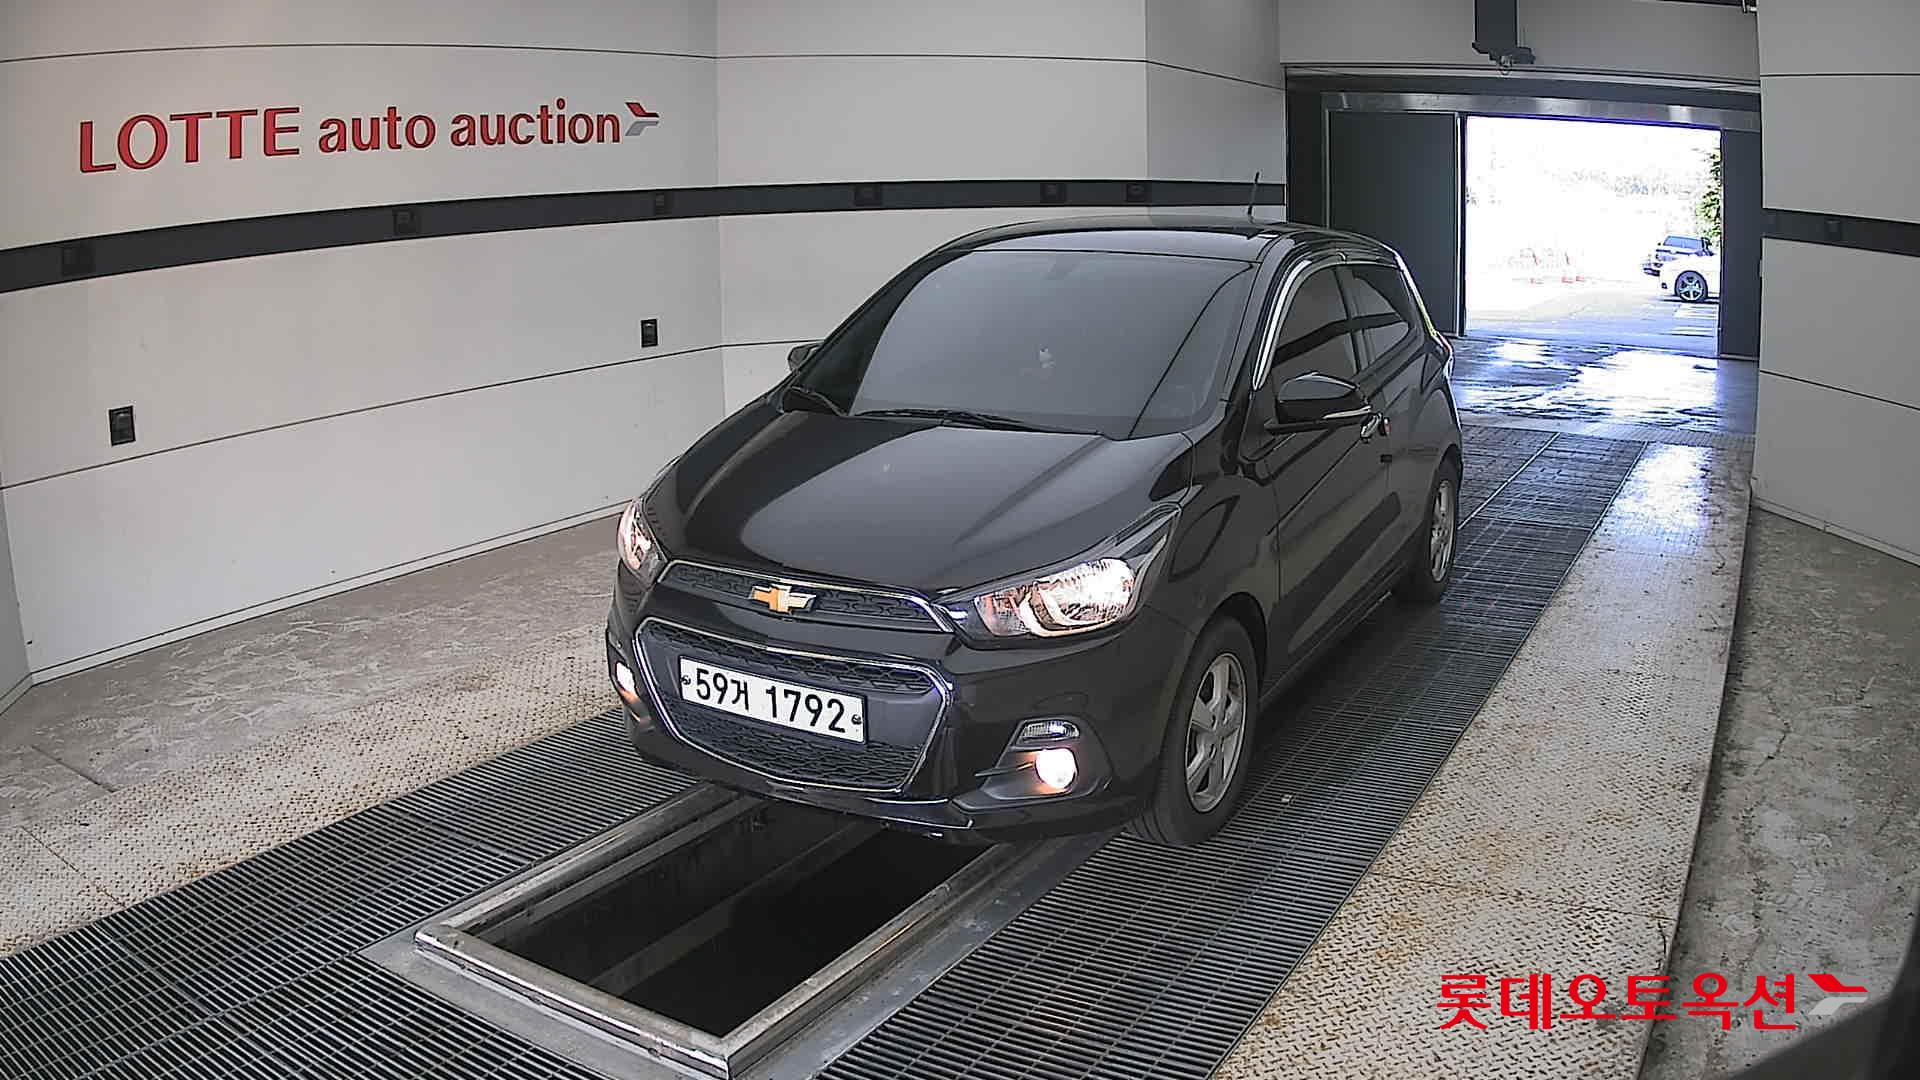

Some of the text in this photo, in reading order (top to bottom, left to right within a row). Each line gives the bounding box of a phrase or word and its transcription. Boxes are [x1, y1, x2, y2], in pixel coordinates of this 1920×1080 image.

[79, 98, 622, 173] LOTTE auto auction
[696, 667, 846, 734] 59거 1792
